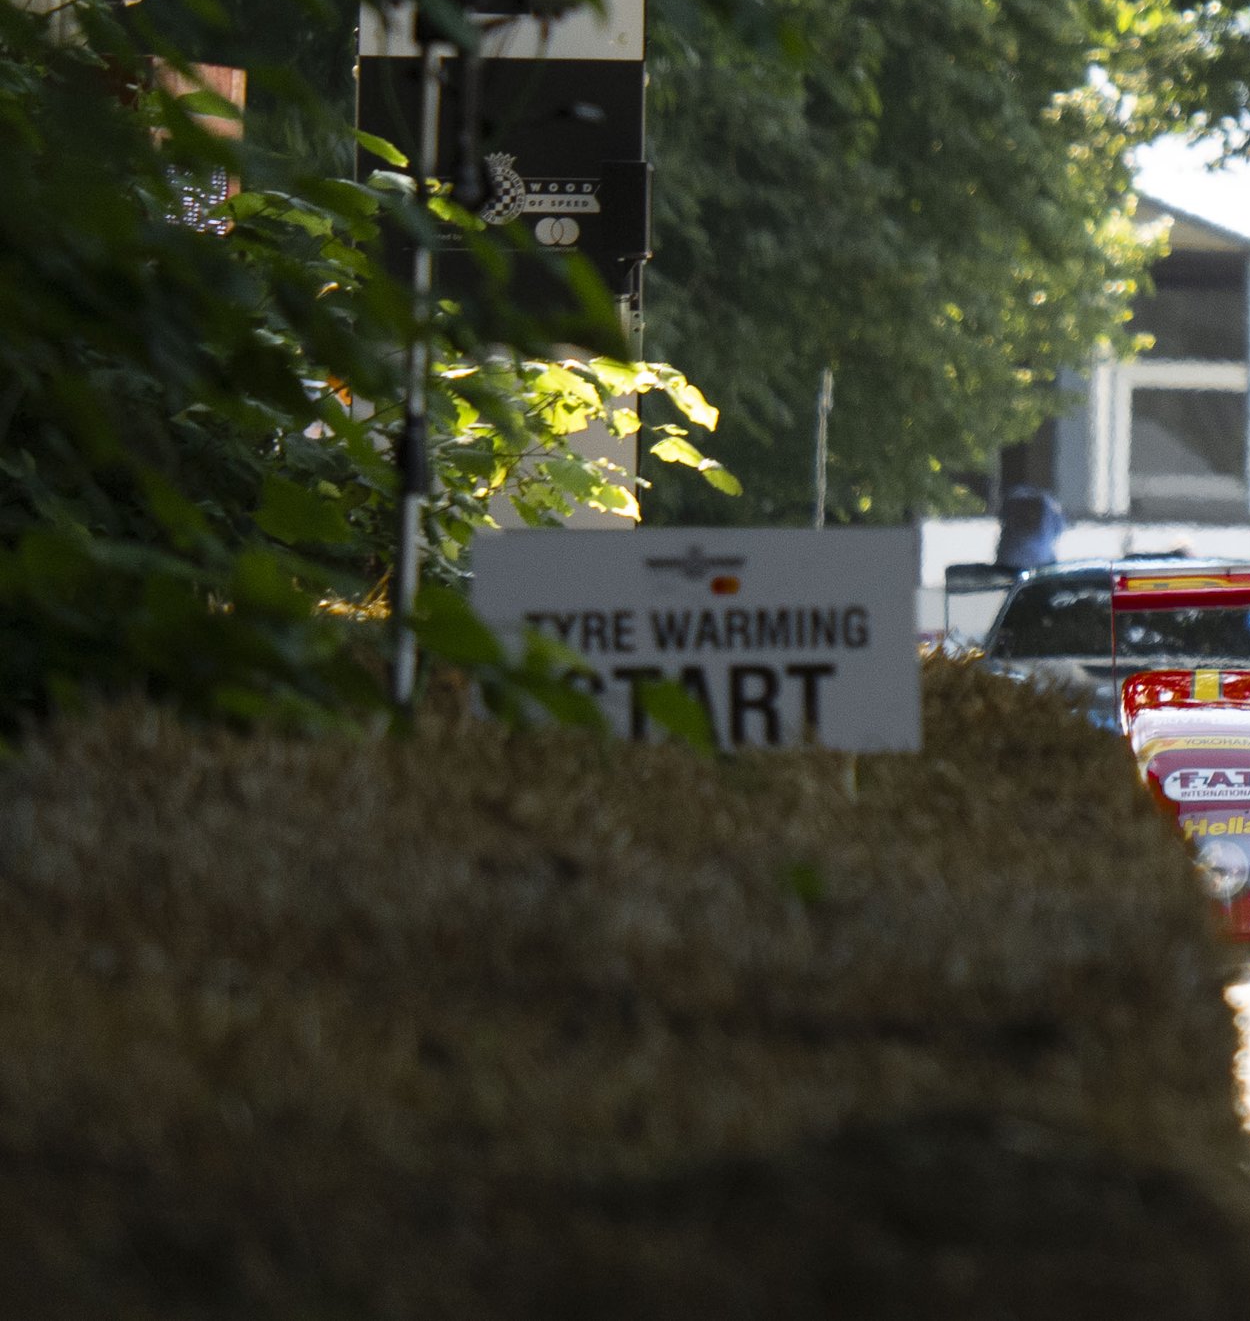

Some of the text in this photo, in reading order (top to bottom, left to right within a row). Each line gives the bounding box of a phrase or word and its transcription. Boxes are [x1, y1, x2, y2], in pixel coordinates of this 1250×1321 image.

[530, 182, 593, 193] WOOD
[529, 199, 590, 208] OF SPEED
[651, 603, 870, 651] WARMING
